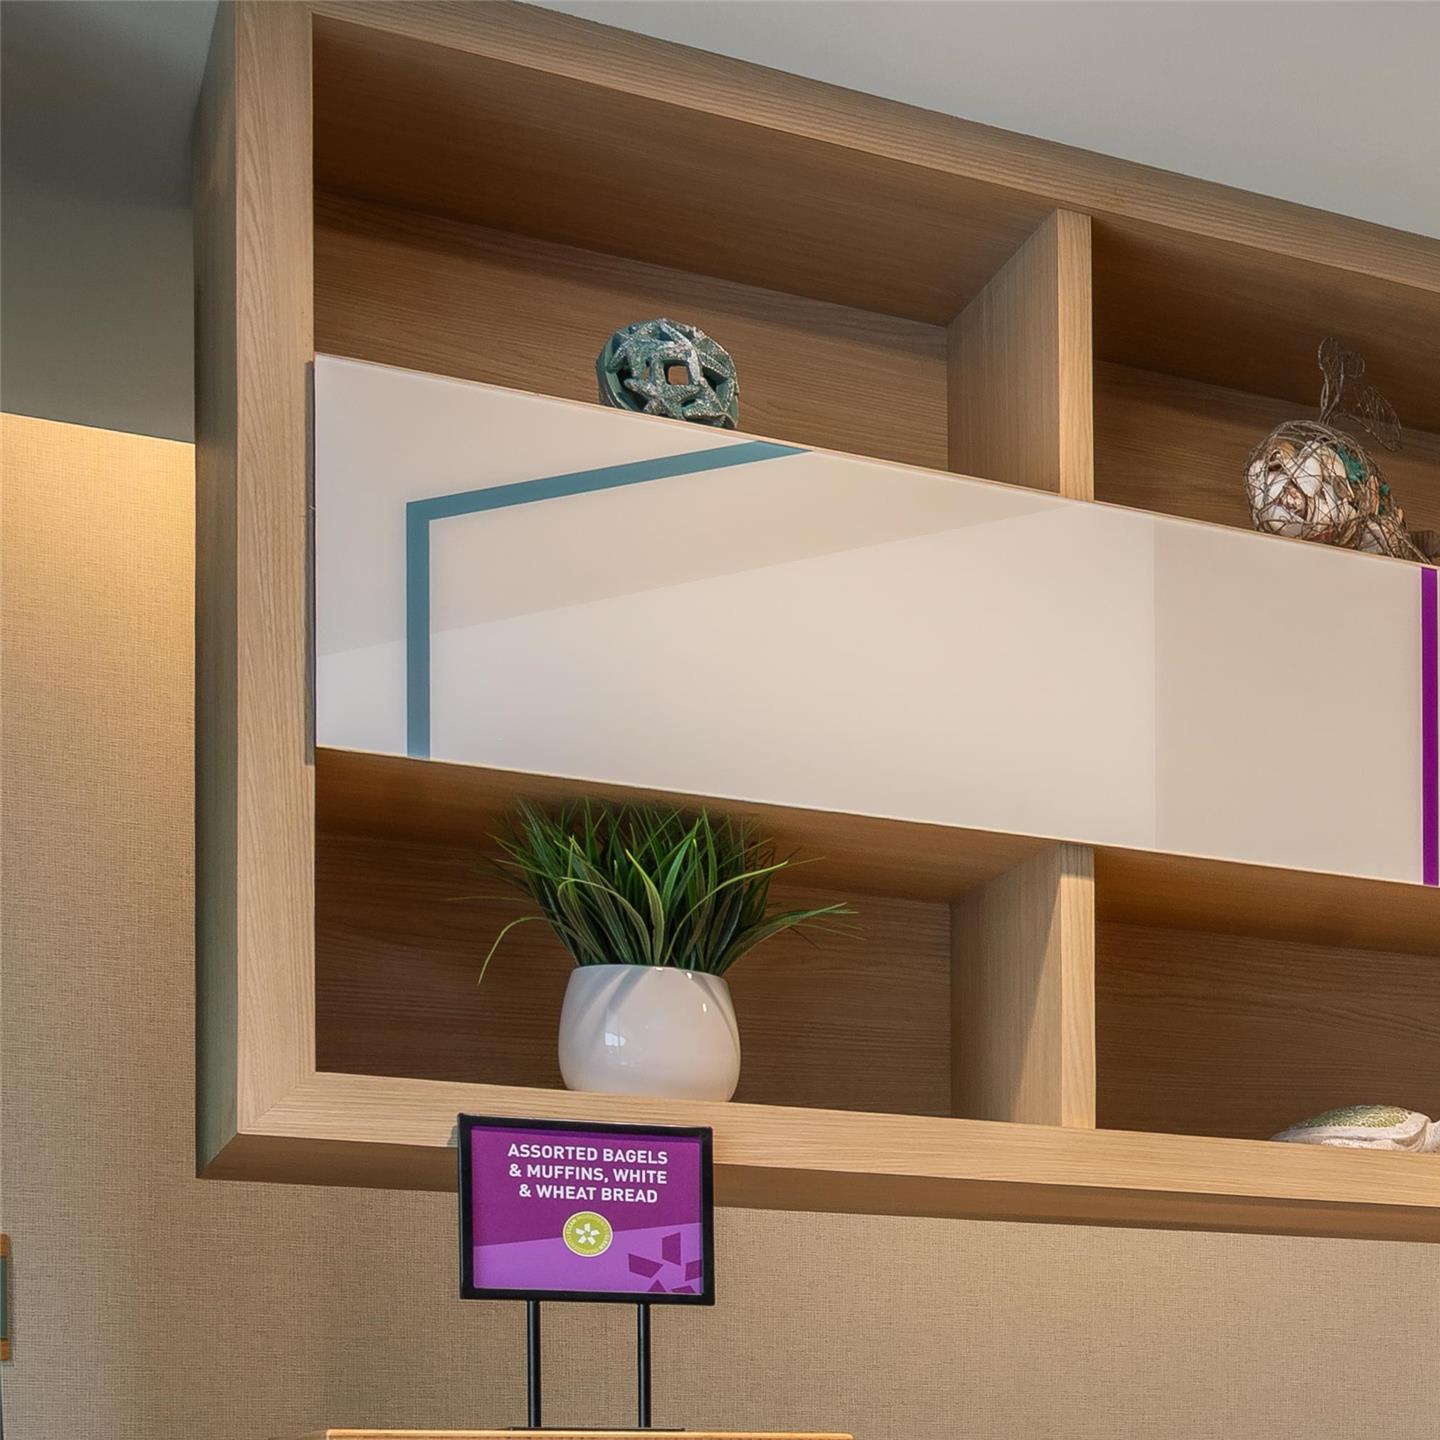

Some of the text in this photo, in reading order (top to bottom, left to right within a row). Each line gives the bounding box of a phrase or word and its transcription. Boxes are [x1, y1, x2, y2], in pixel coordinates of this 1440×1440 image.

[507, 1144, 668, 1164] ASSORTED BAGELS
[509, 1164, 667, 1184] & MUFFINS, WHITE
[519, 1184, 657, 1203] & WHEAT BREAD
